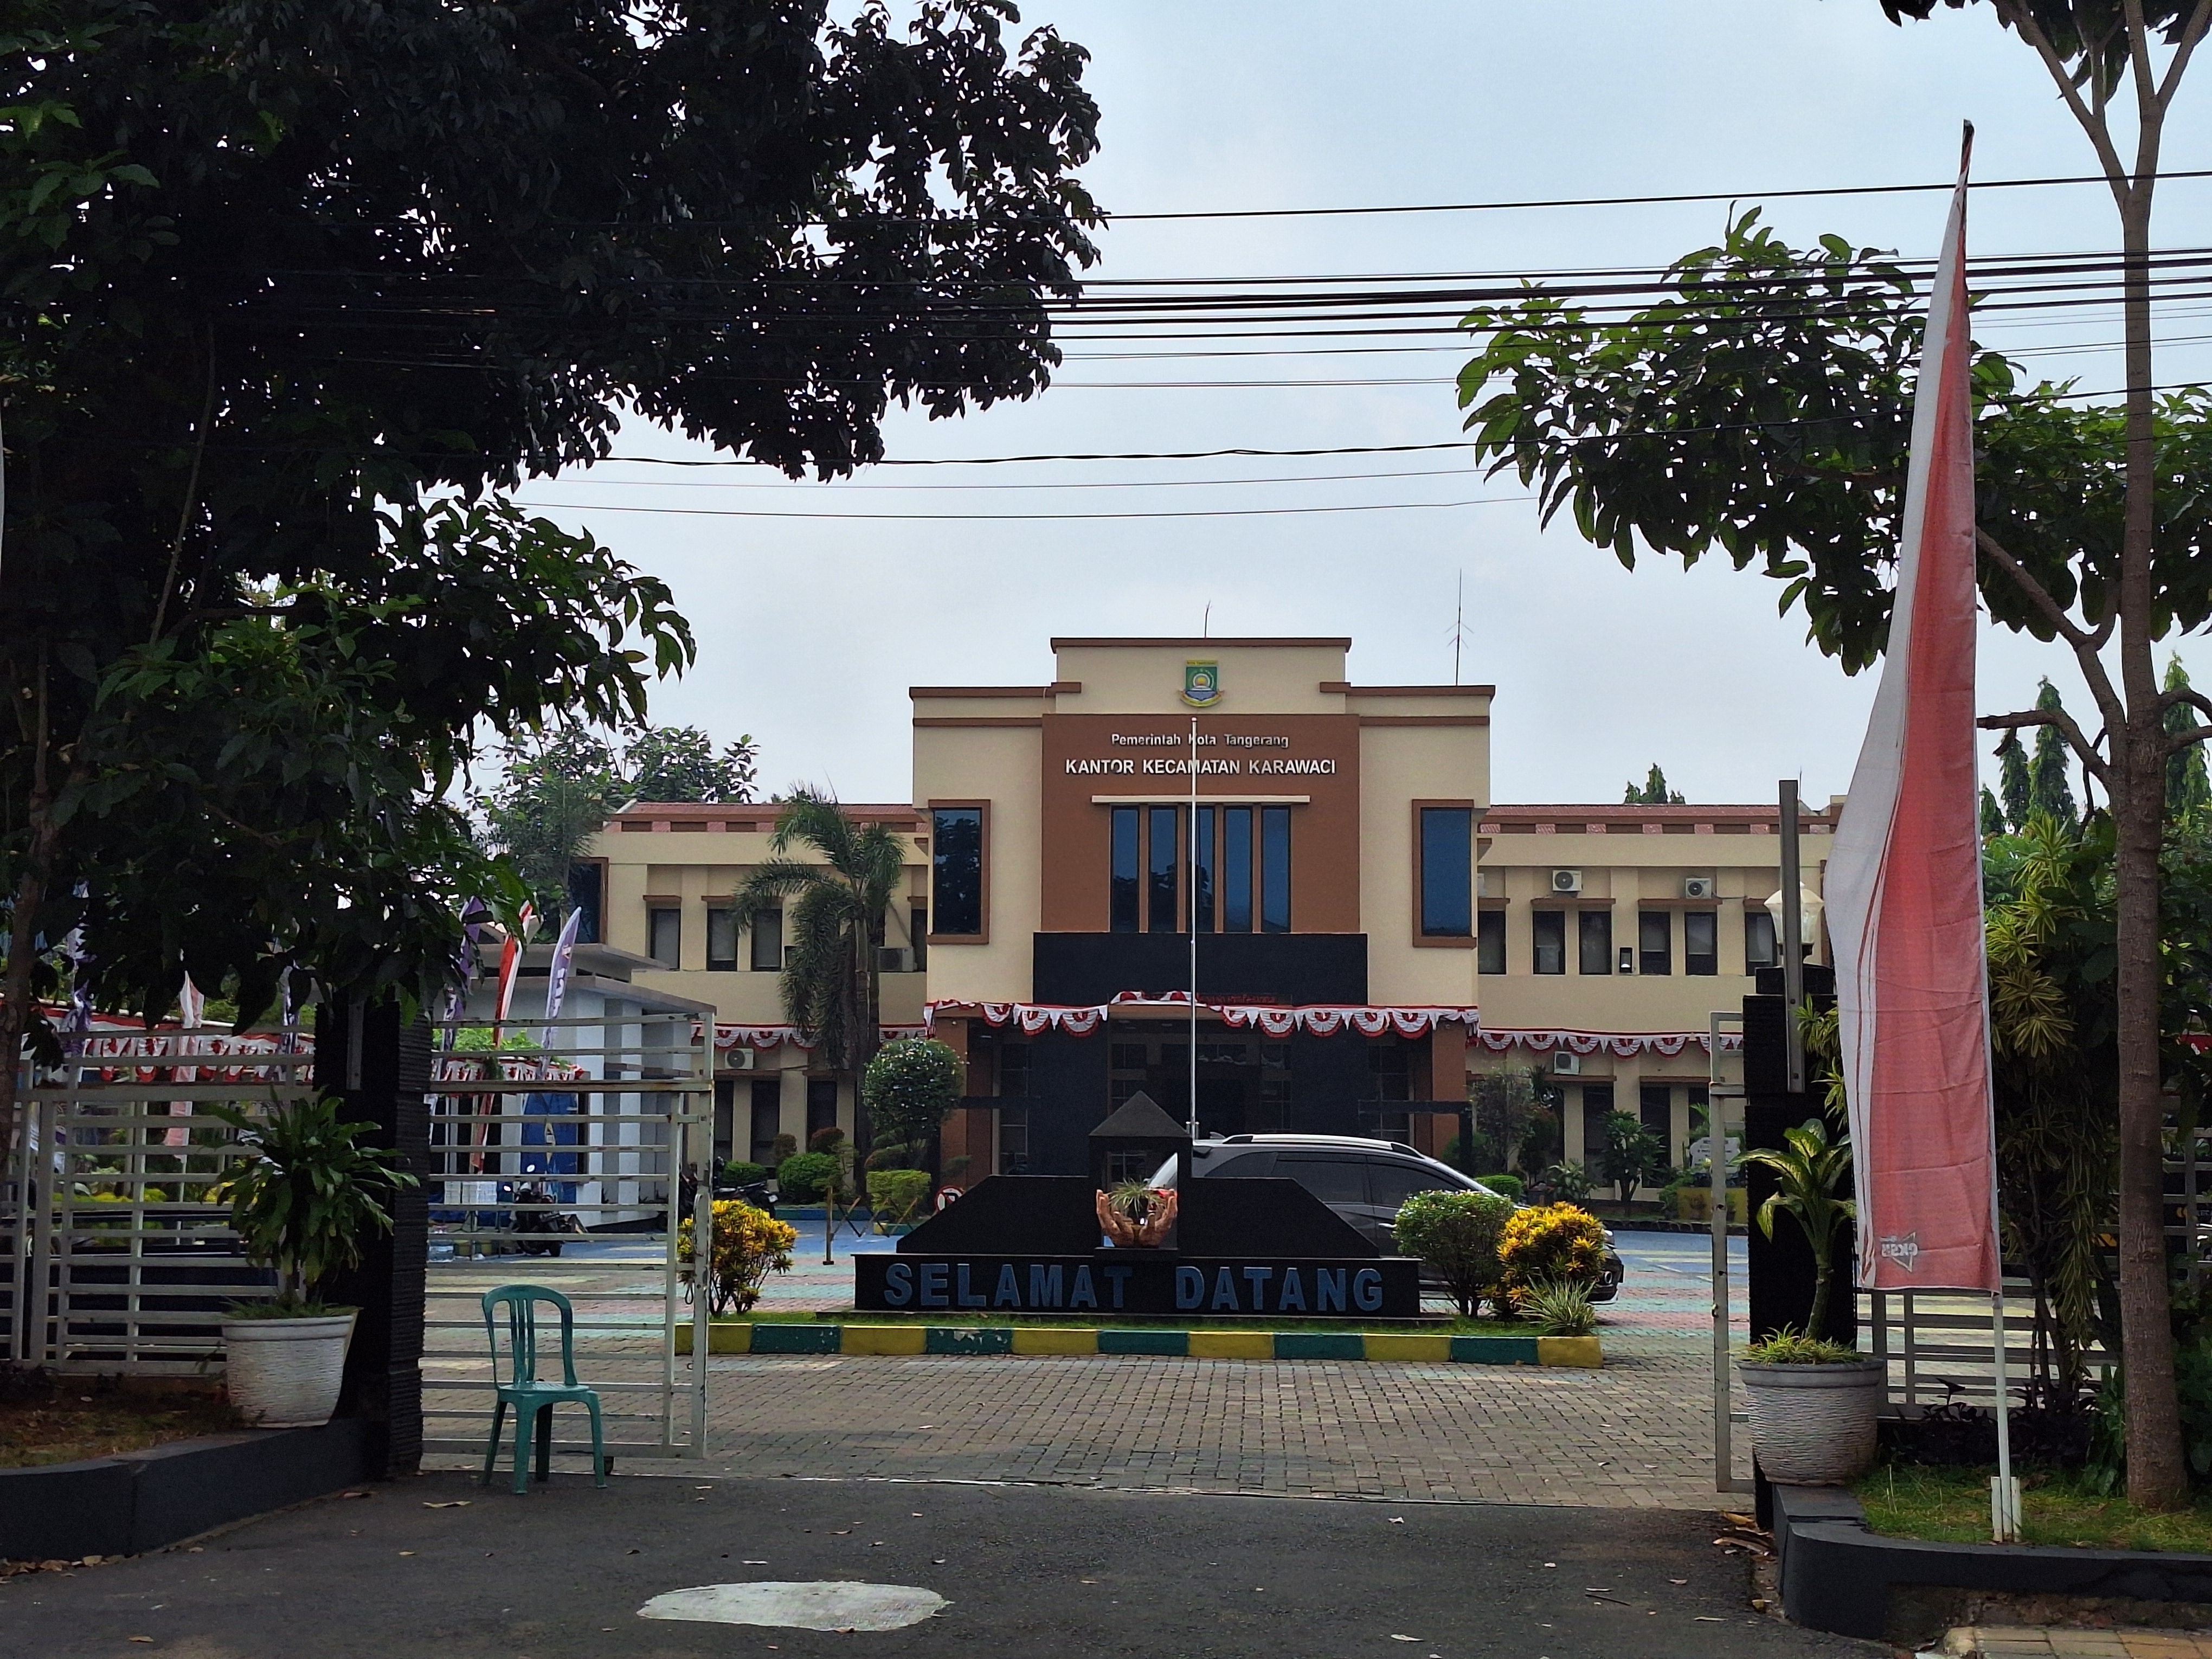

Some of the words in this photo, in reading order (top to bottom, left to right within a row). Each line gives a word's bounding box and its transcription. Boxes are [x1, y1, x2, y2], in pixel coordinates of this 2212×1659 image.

[1111, 733, 1181, 746] Pemerintah
[1224, 734, 1289, 748] Tangerang
[1065, 758, 1135, 774] KANTOR
[1142, 758, 1240, 774] KECAMATAN
[1249, 758, 1336, 774] KARAWACI
[884, 1263, 1133, 1309] SELAMAT
[1176, 1266, 1382, 1311] DATANG
